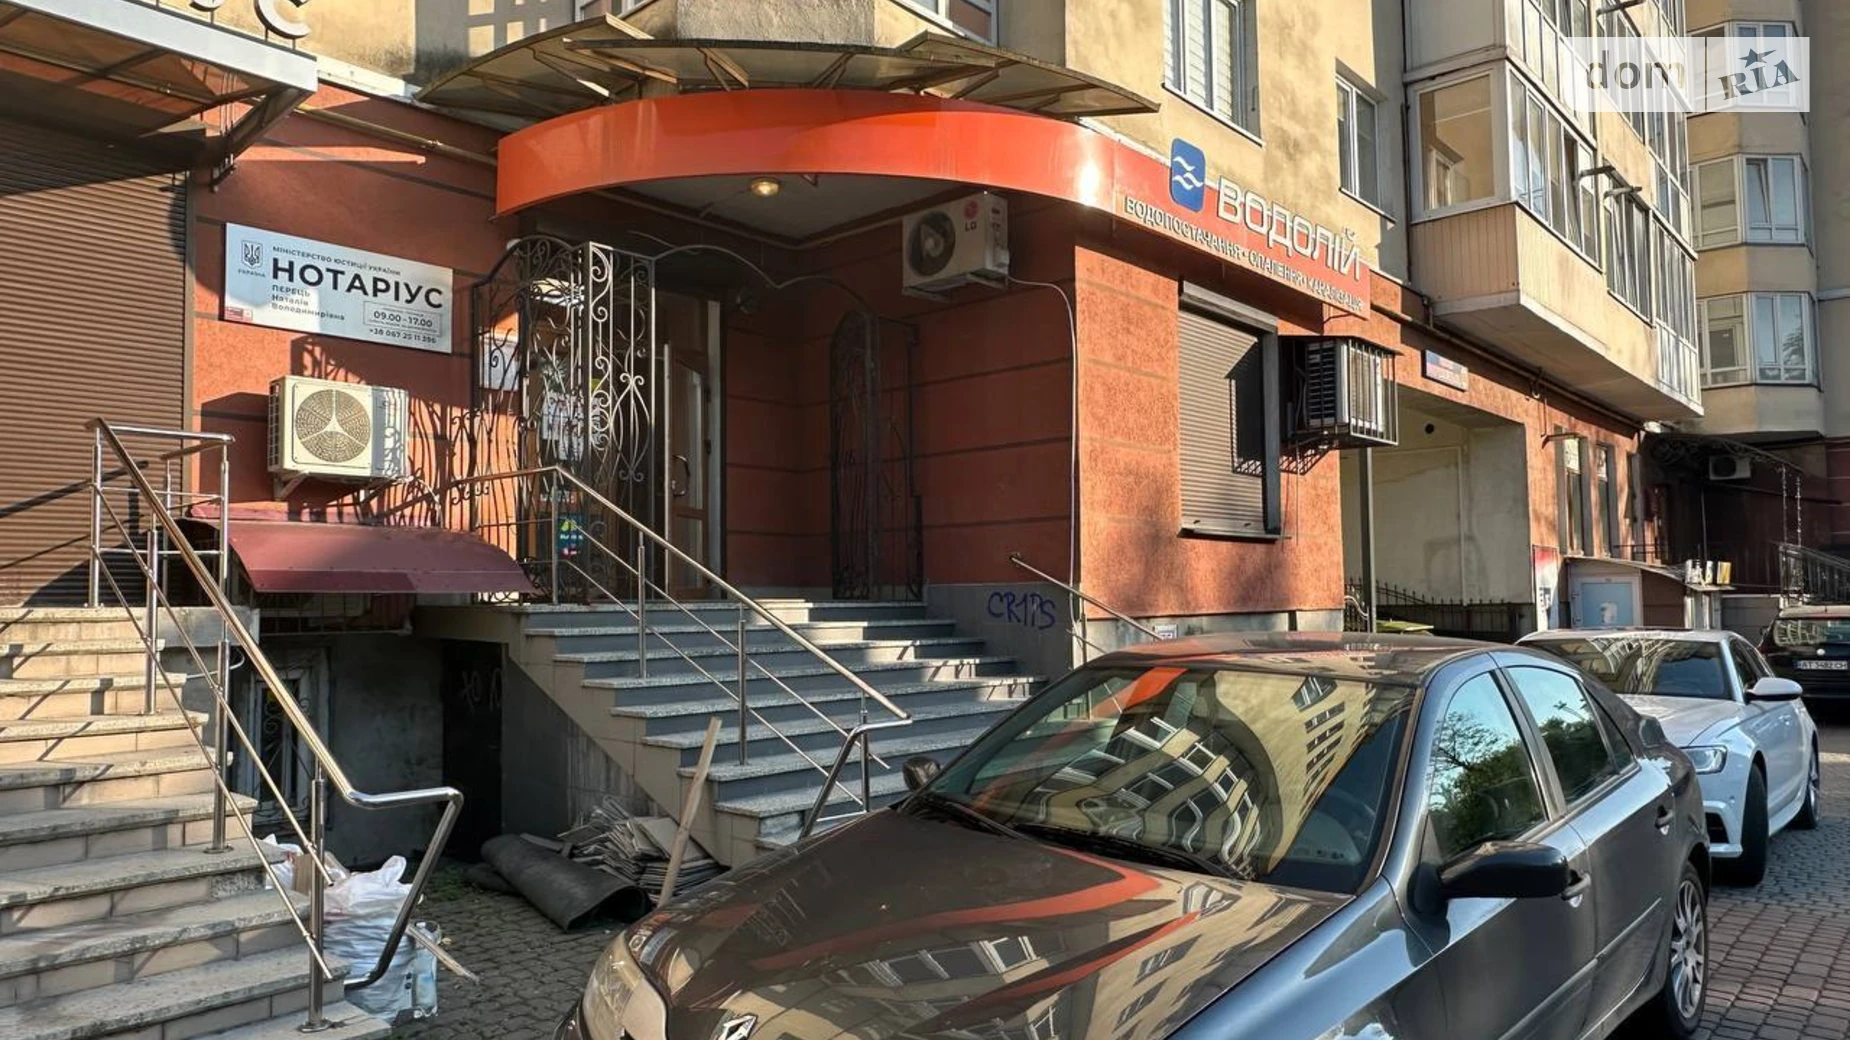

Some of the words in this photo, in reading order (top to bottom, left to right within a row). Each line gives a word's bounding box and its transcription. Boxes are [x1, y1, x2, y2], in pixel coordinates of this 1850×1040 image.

[964, 220, 978, 233] LG
[1217, 175, 1361, 282] ВОДОЛІЙ
[272, 246, 332, 263] МІНІСТЕРСТВО
[333, 258, 367, 270] ЮСТИЦІЇ
[368, 263, 401, 276] УКРАЇНИ
[272, 257, 443, 309] НОТАРІУС
[373, 310, 401, 323] 09.00
[408, 316, 433, 328] 17.00
